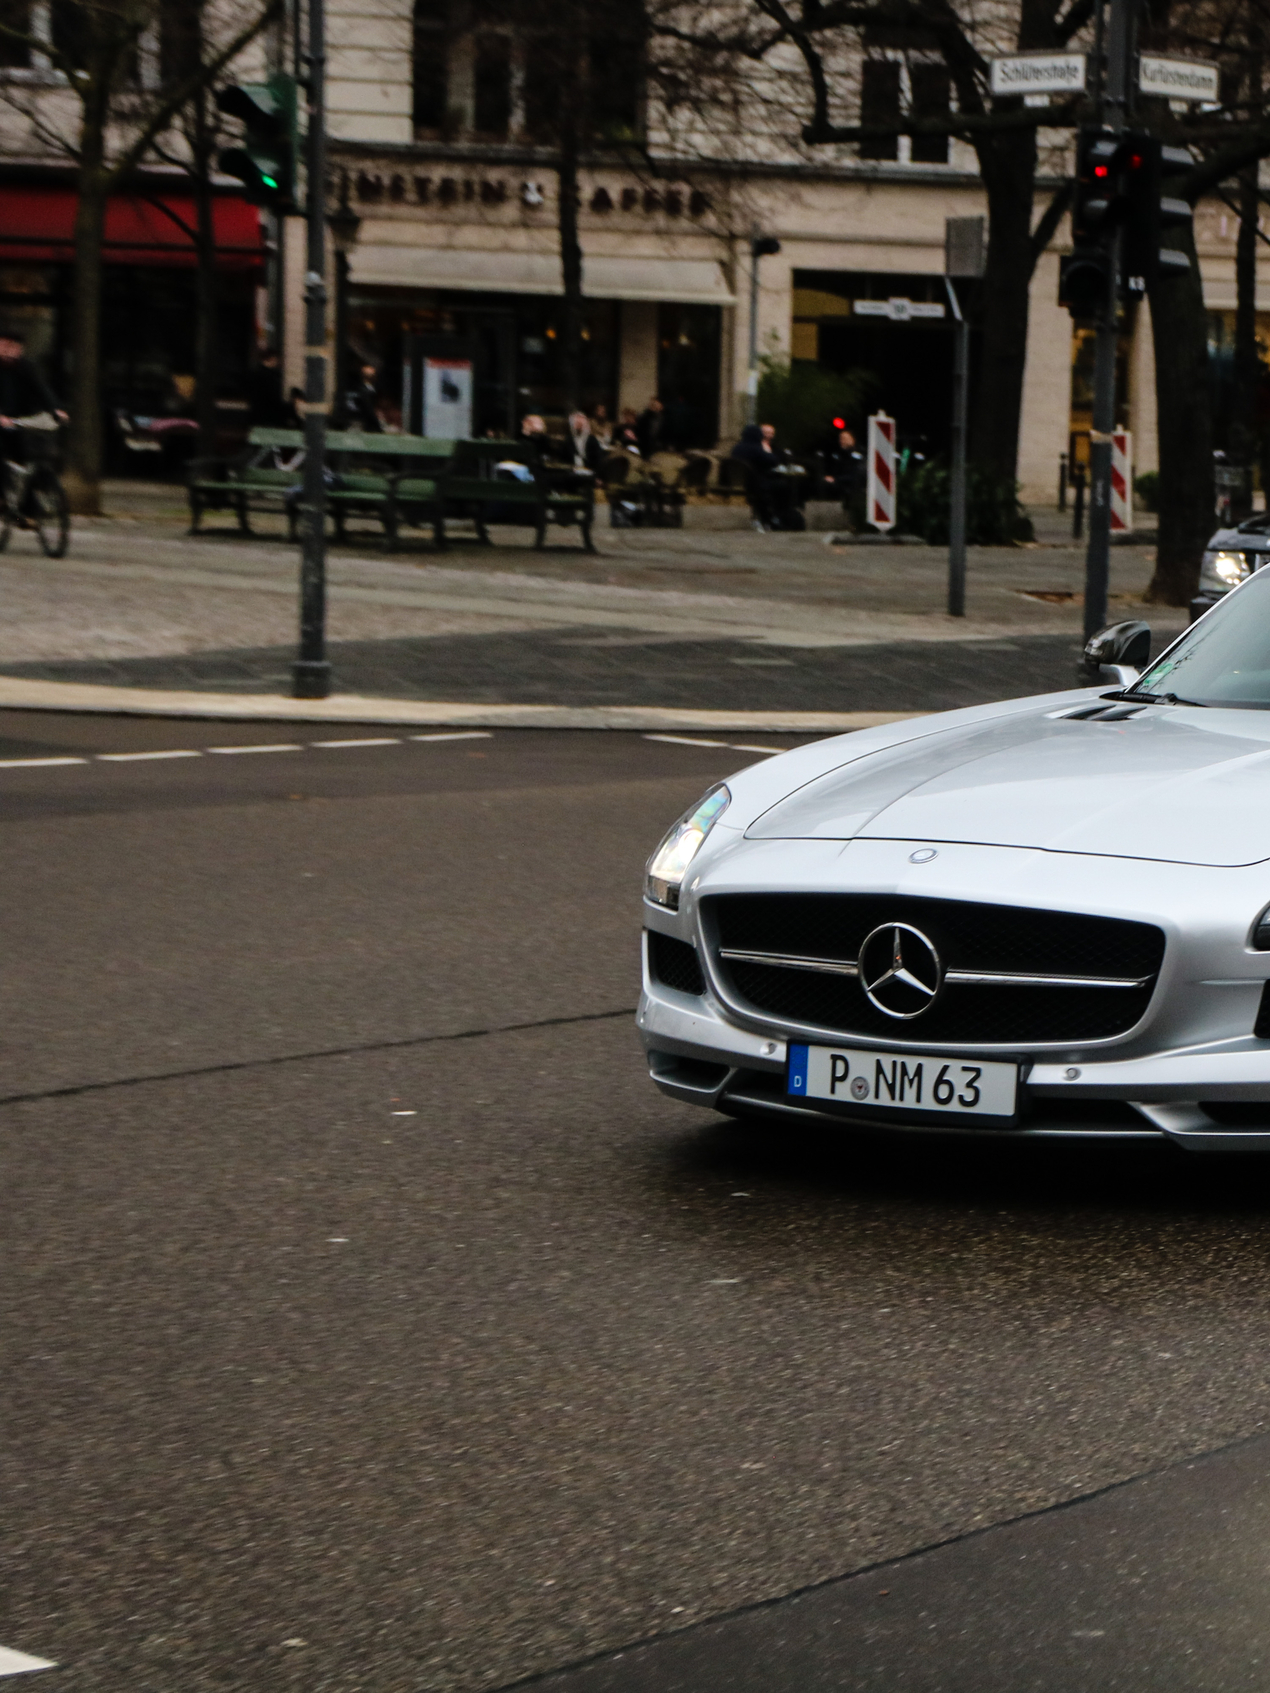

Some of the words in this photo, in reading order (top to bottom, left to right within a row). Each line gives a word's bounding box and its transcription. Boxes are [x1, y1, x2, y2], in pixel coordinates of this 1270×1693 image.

[793, 1075, 803, 1088] D
[830, 1053, 850, 1095] P
[874, 1058, 924, 1104] NM
[933, 1064, 983, 1108] 63
